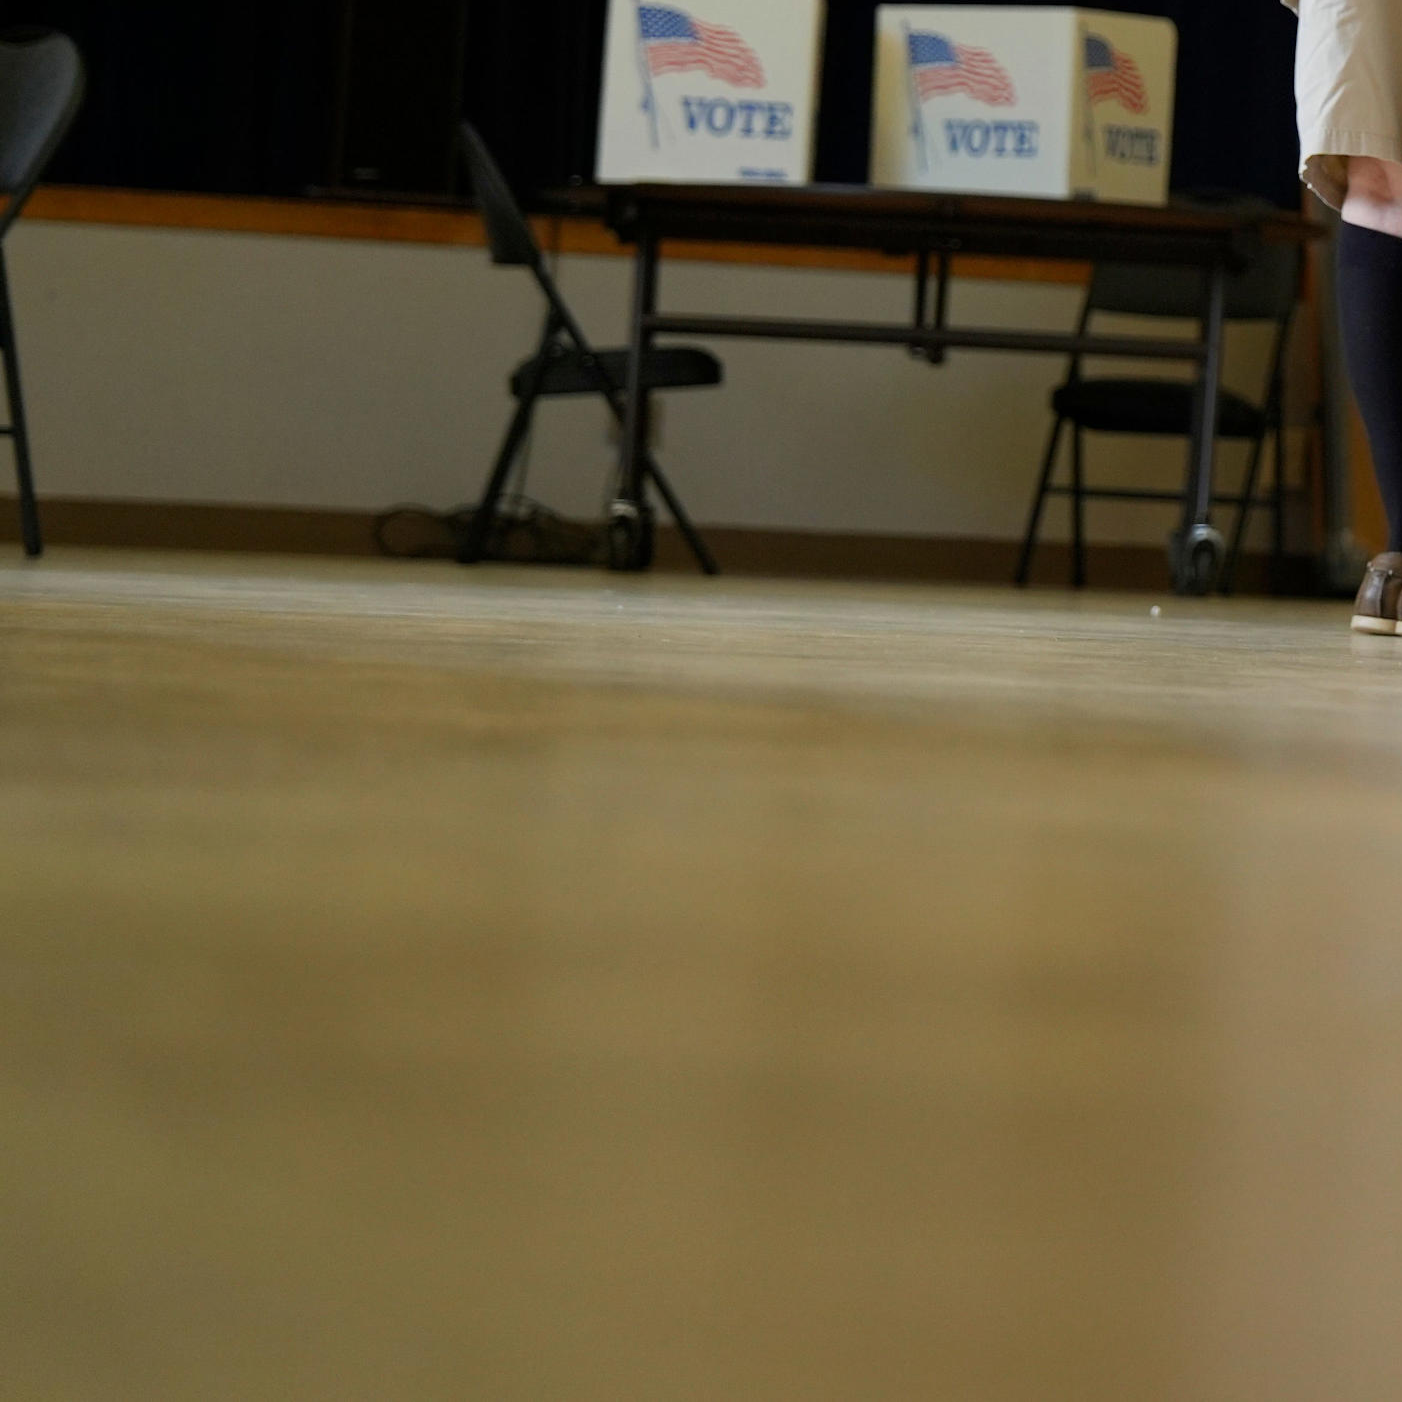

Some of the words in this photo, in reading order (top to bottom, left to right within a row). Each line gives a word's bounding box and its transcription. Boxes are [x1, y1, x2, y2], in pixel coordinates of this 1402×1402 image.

[680, 96, 794, 140] VOTE
[943, 117, 1039, 158] VOTE
[1104, 123, 1159, 166] VOTE
